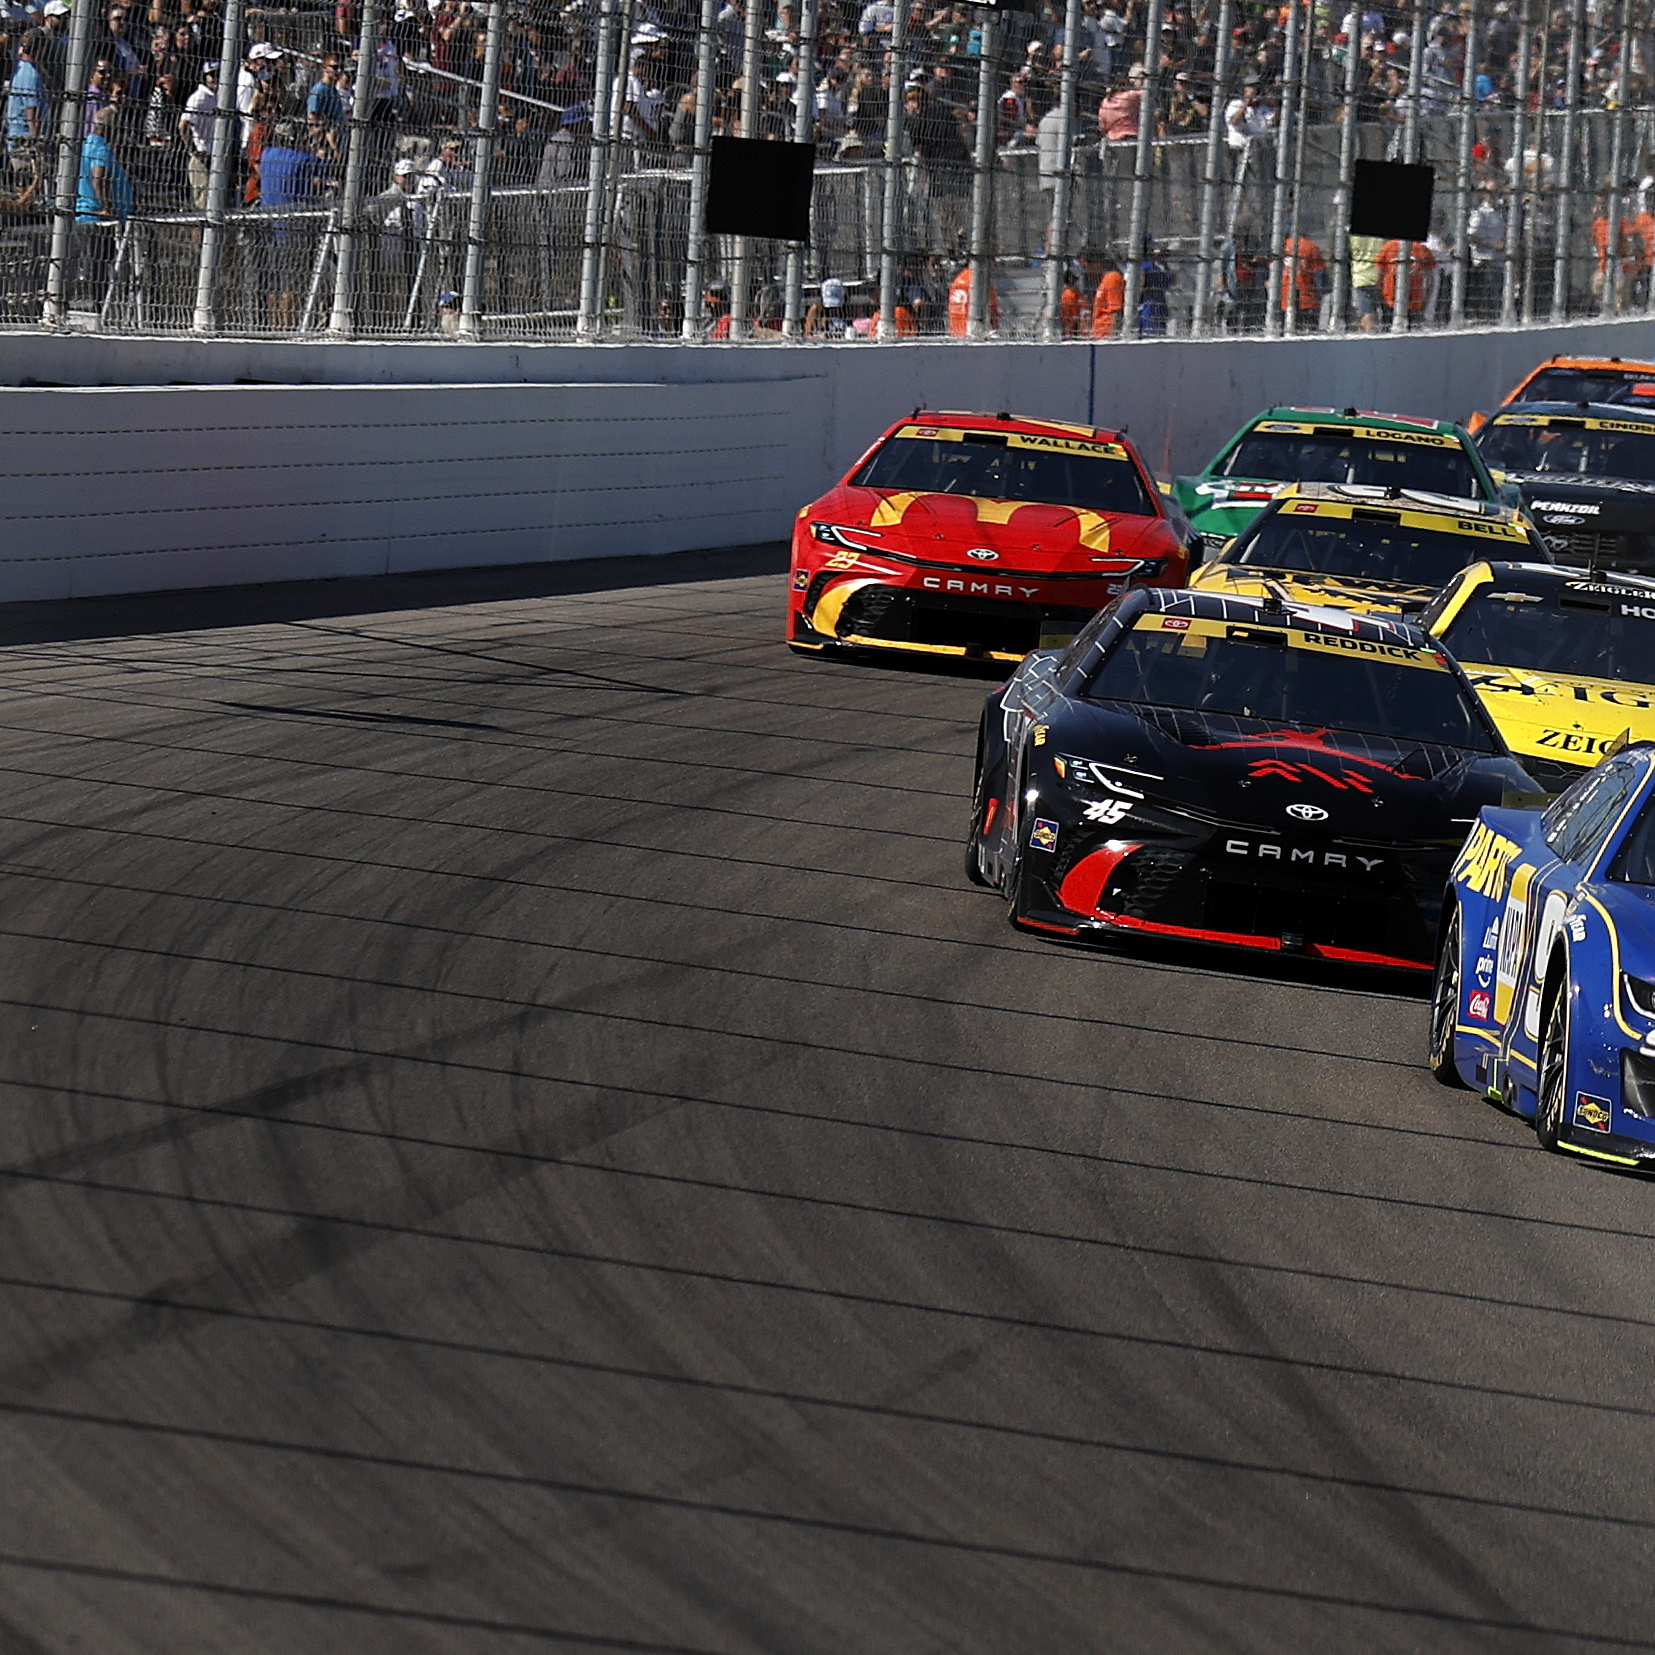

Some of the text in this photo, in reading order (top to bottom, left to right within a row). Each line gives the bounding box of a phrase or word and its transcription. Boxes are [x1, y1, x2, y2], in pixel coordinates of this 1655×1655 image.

[1020, 434, 1117, 455] WALLACE
[1365, 428, 1445, 447] LOGANO
[1458, 519, 1517, 538] BELL
[923, 576, 1041, 597] CAMRY
[1303, 631, 1423, 663] REDDICK
[1226, 839, 1385, 871] CAMRY
